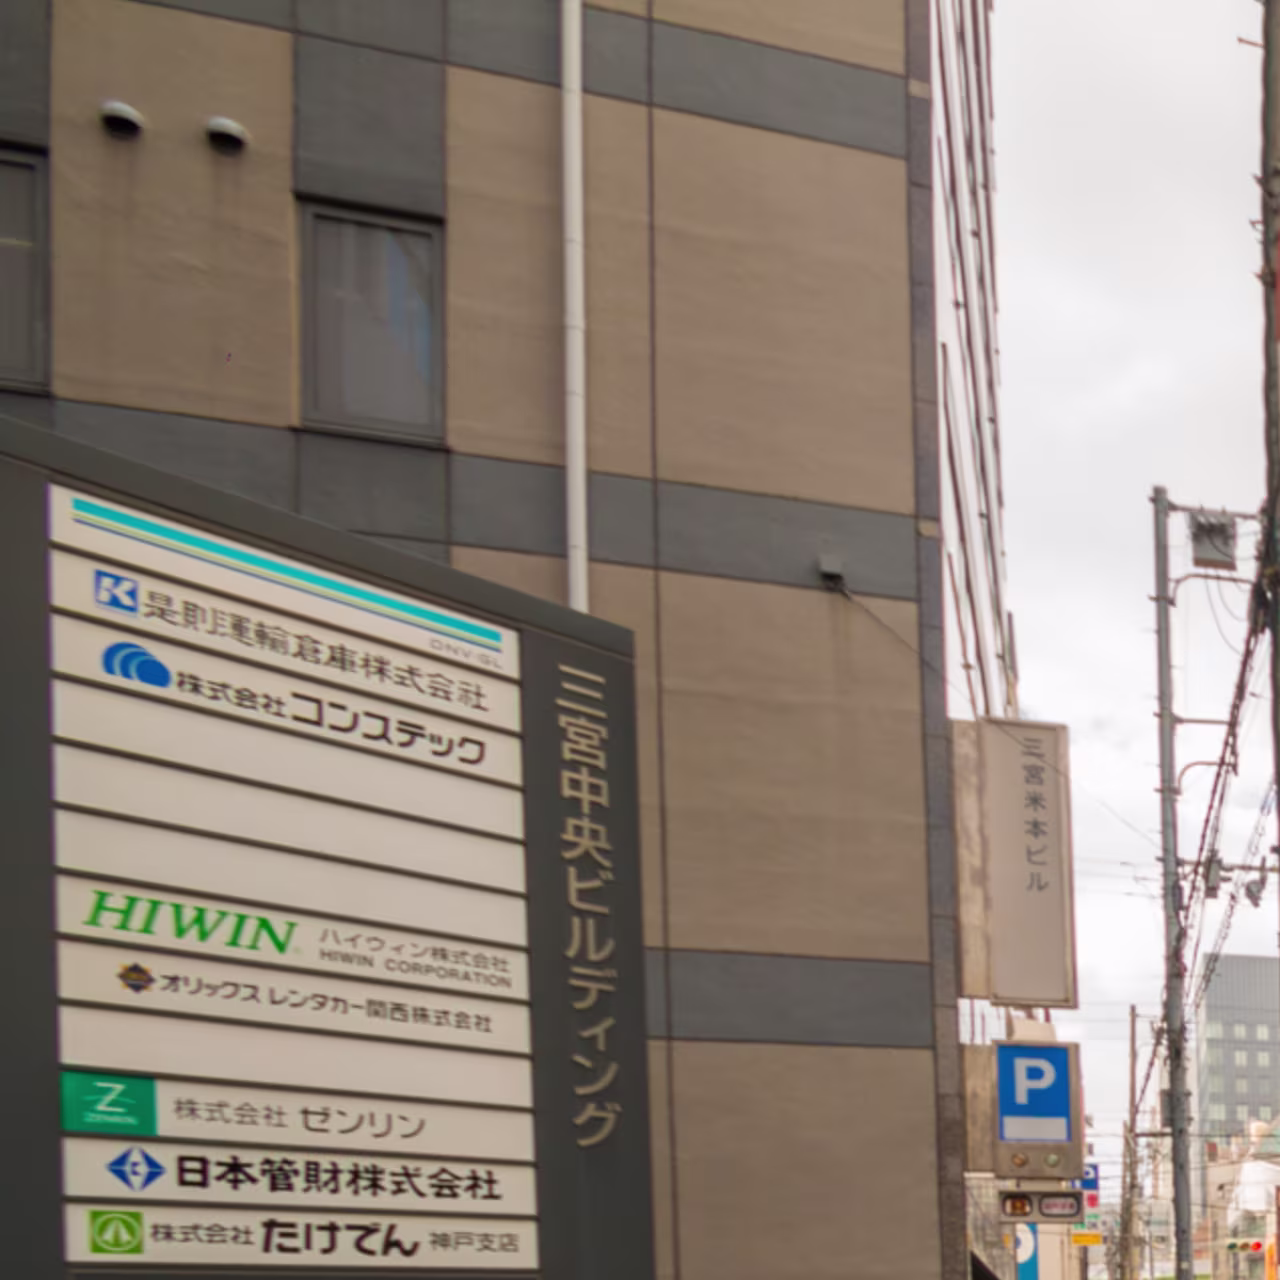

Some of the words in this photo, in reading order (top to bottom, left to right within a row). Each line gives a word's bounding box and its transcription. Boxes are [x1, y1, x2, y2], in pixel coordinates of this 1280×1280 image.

[143, 590, 490, 713] 是則運輸倉庫株式会社
[82, 889, 298, 955] HIWIN
[555, 663, 623, 1148] 三宮中央ビルディング
[319, 928, 512, 973] ハイウィン株式会社
[319, 948, 375, 969] HIWIN
[384, 958, 513, 989] CORPORATION
[1013, 1056, 1057, 1106] P
[177, 1155, 502, 1200] 日本管財株式会社
